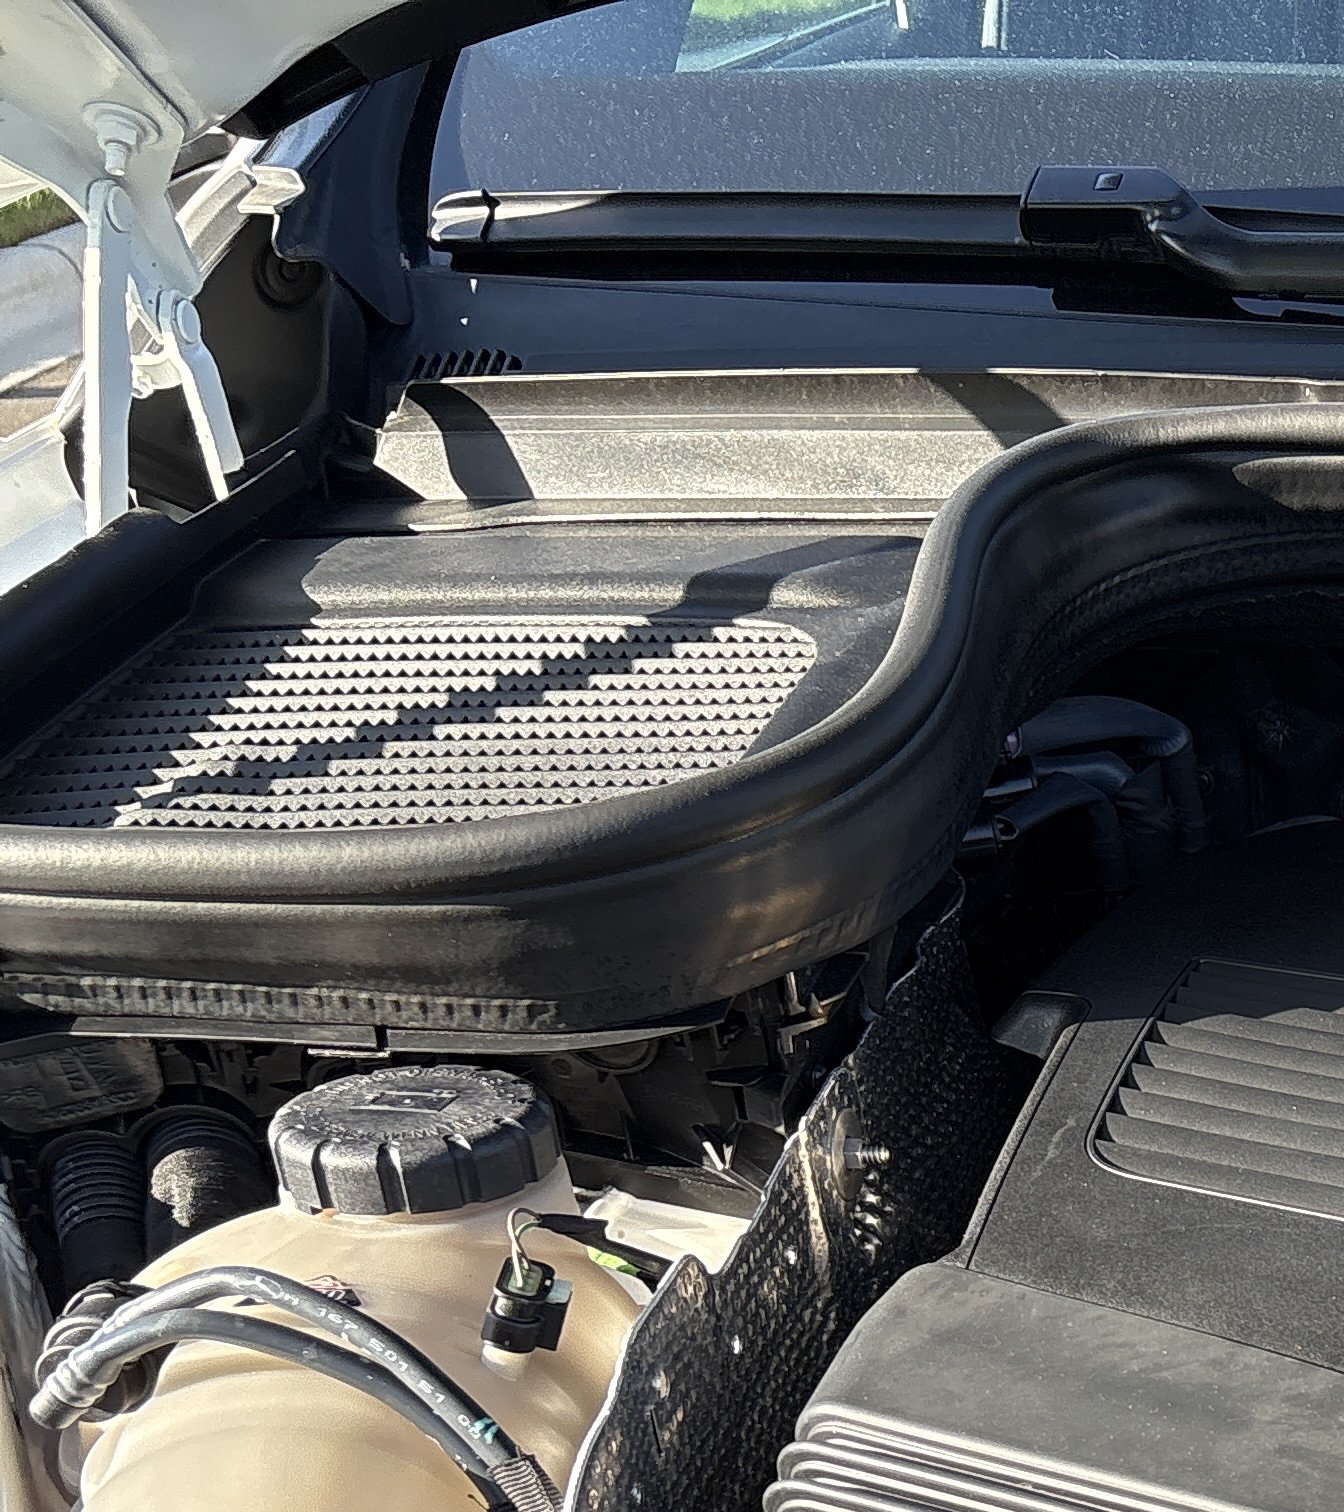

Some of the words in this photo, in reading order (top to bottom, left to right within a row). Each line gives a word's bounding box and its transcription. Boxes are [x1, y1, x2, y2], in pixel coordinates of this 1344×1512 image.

[316, 1307, 359, 1330] 167
[368, 1337, 409, 1372] 501
[417, 1379, 447, 1403] 51
